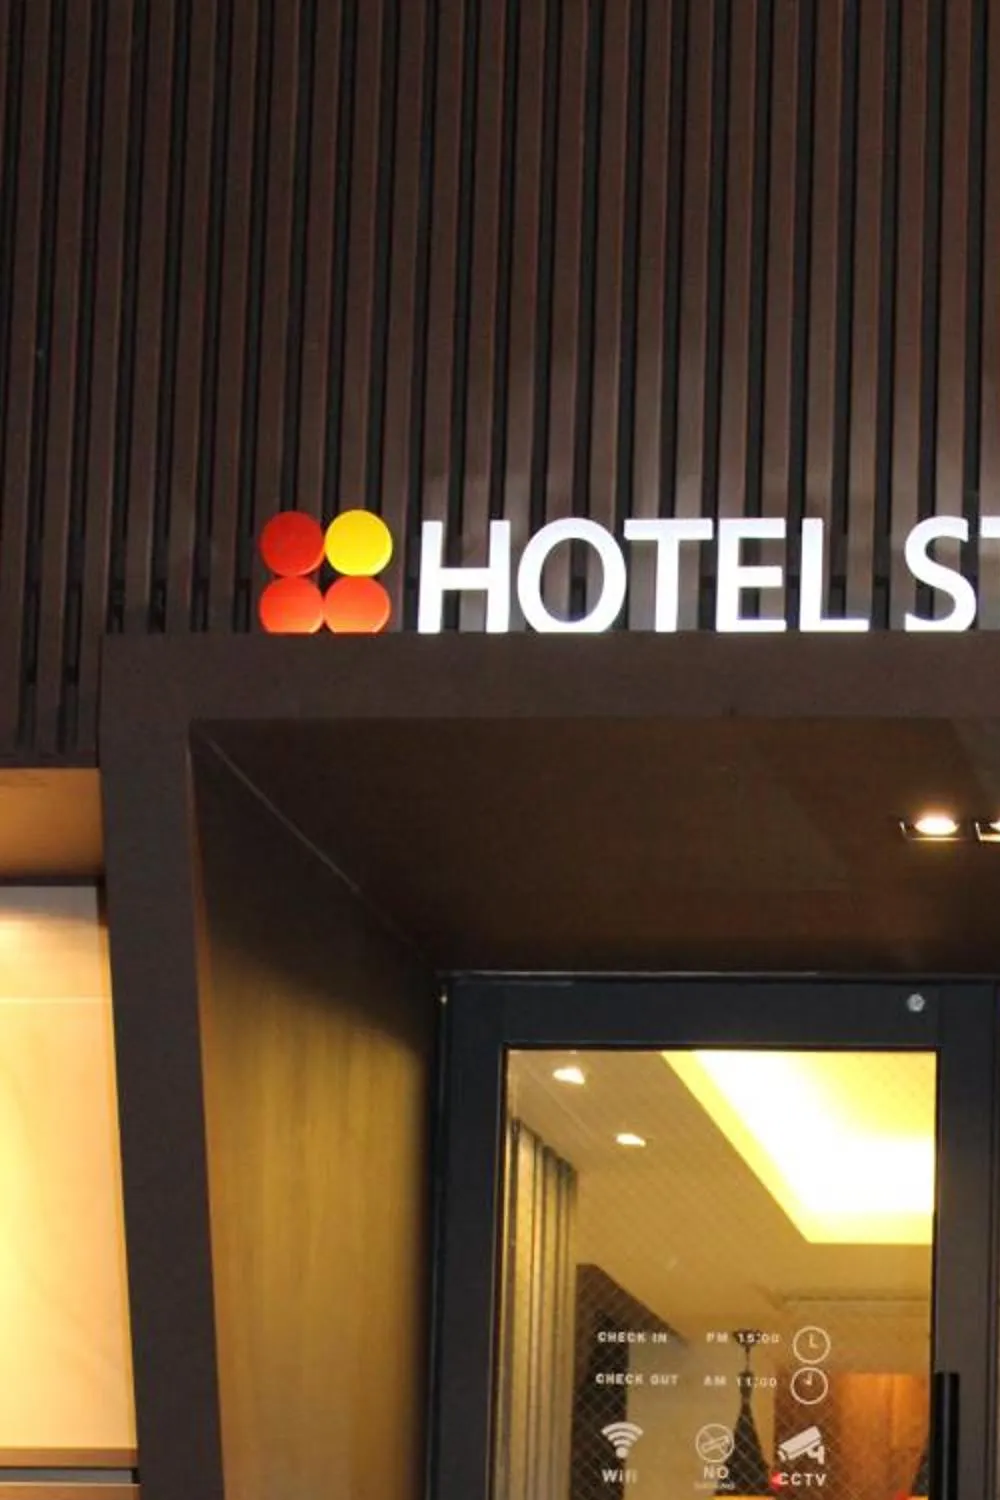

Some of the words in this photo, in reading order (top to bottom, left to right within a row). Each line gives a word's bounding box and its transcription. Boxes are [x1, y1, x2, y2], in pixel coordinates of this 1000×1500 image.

[416, 517, 870, 634] HOTEL
[597, 1331, 647, 1343] CHECK
[651, 1331, 668, 1343] IN
[705, 1332, 729, 1344] PM
[595, 1373, 644, 1385] CHECK
[650, 1374, 680, 1386] OUT
[703, 1374, 727, 1386] AM
[703, 1465, 730, 1480] NO
[778, 1471, 827, 1487] CCTV
